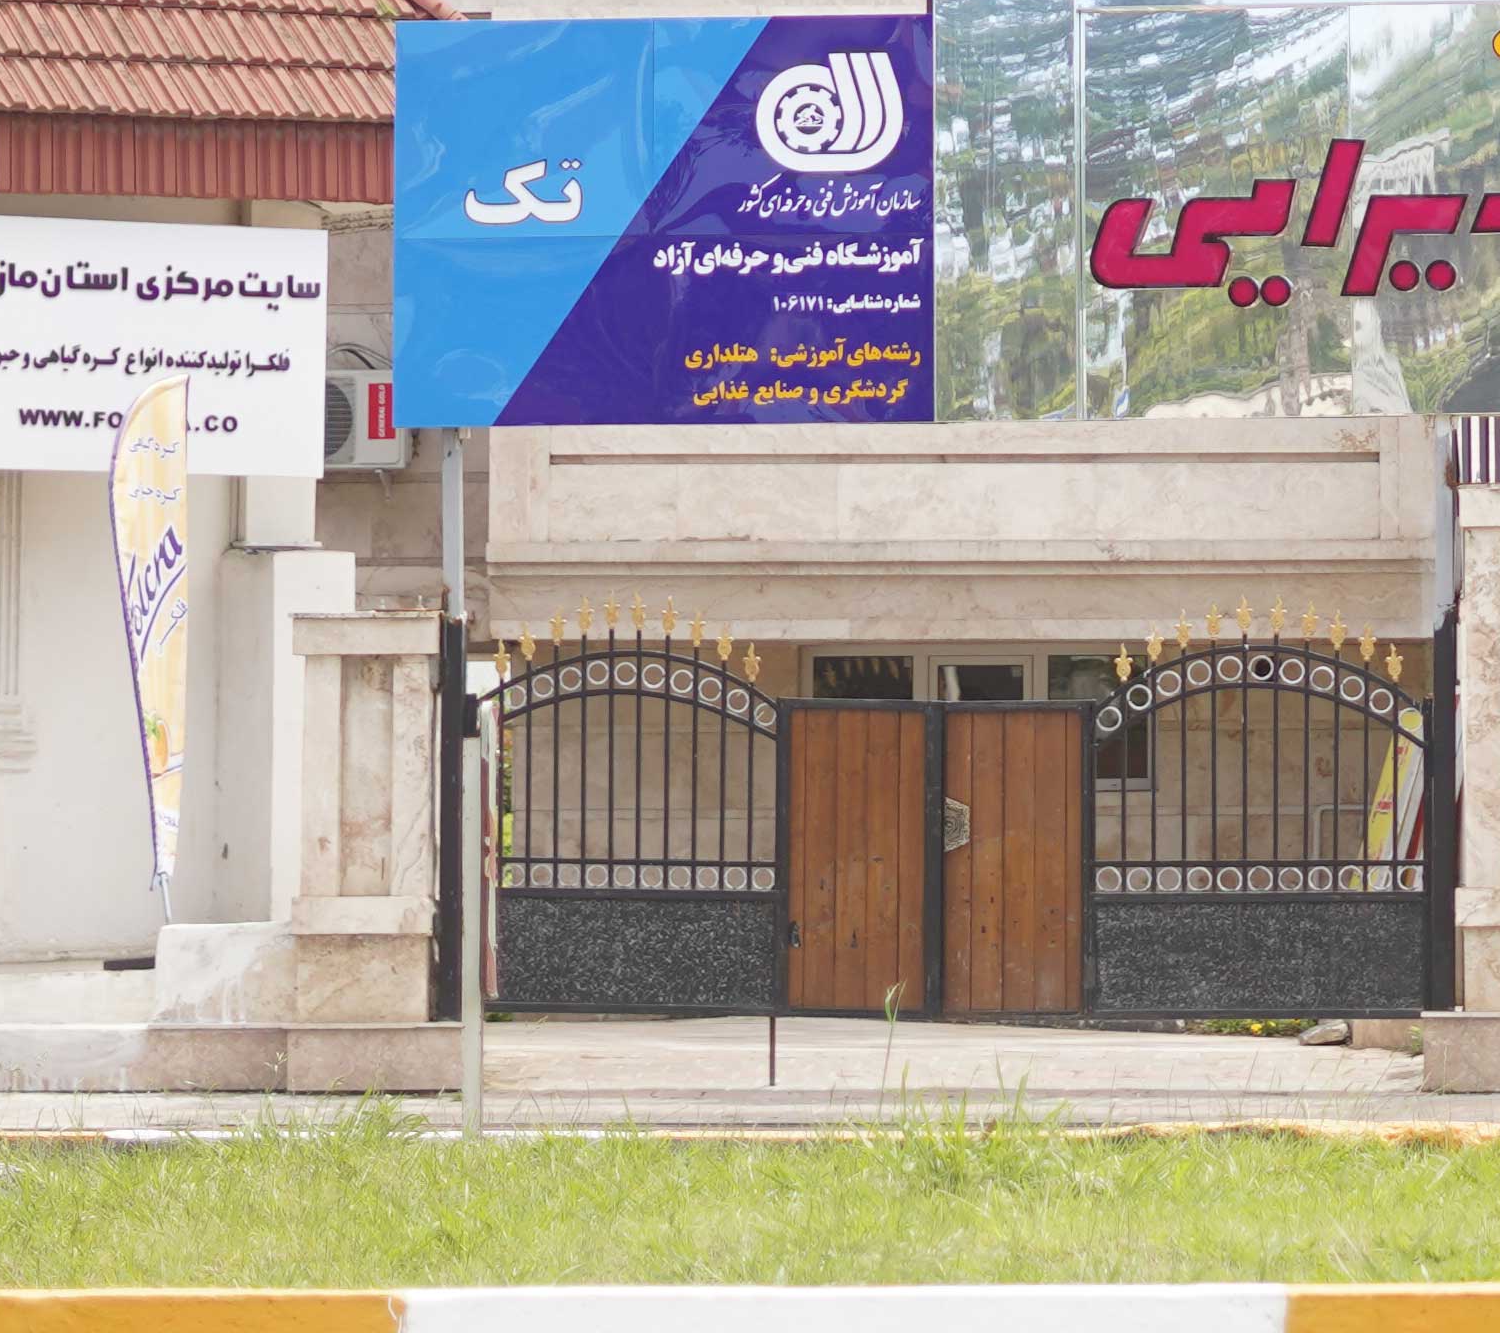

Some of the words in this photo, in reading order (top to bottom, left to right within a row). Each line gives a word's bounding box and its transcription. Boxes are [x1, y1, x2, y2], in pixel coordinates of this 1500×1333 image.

[463, 156, 584, 225] تک
[737, 172, 782, 213] کشور
[812, 179, 834, 217] فنی
[830, 181, 884, 217] آموزش
[875, 189, 922, 217] سازمان
[652, 240, 697, 275] آزاد
[770, 252, 785, 274] و
[783, 241, 825, 274] فنی
[825, 237, 924, 273] آموزشگاه
[40, 261, 130, 298] استان
[136, 265, 234, 302] مرکزی
[237, 269, 322, 312] سایت
[773, 295, 825, 312] ۱۰۶۱۷۱
[884, 293, 922, 313] شماره
[21, 353, 32, 370] و
[32, 344, 82, 371] گیاهی
[82, 347, 121, 372] کره
[124, 347, 165, 376] انواع
[244, 347, 291, 377] فلکرا
[684, 343, 759, 369] هتلداری
[693, 380, 750, 406] غذایی
[752, 380, 804, 405] صنایع
[809, 386, 819, 405] و
[822, 377, 910, 405] گردشگری
